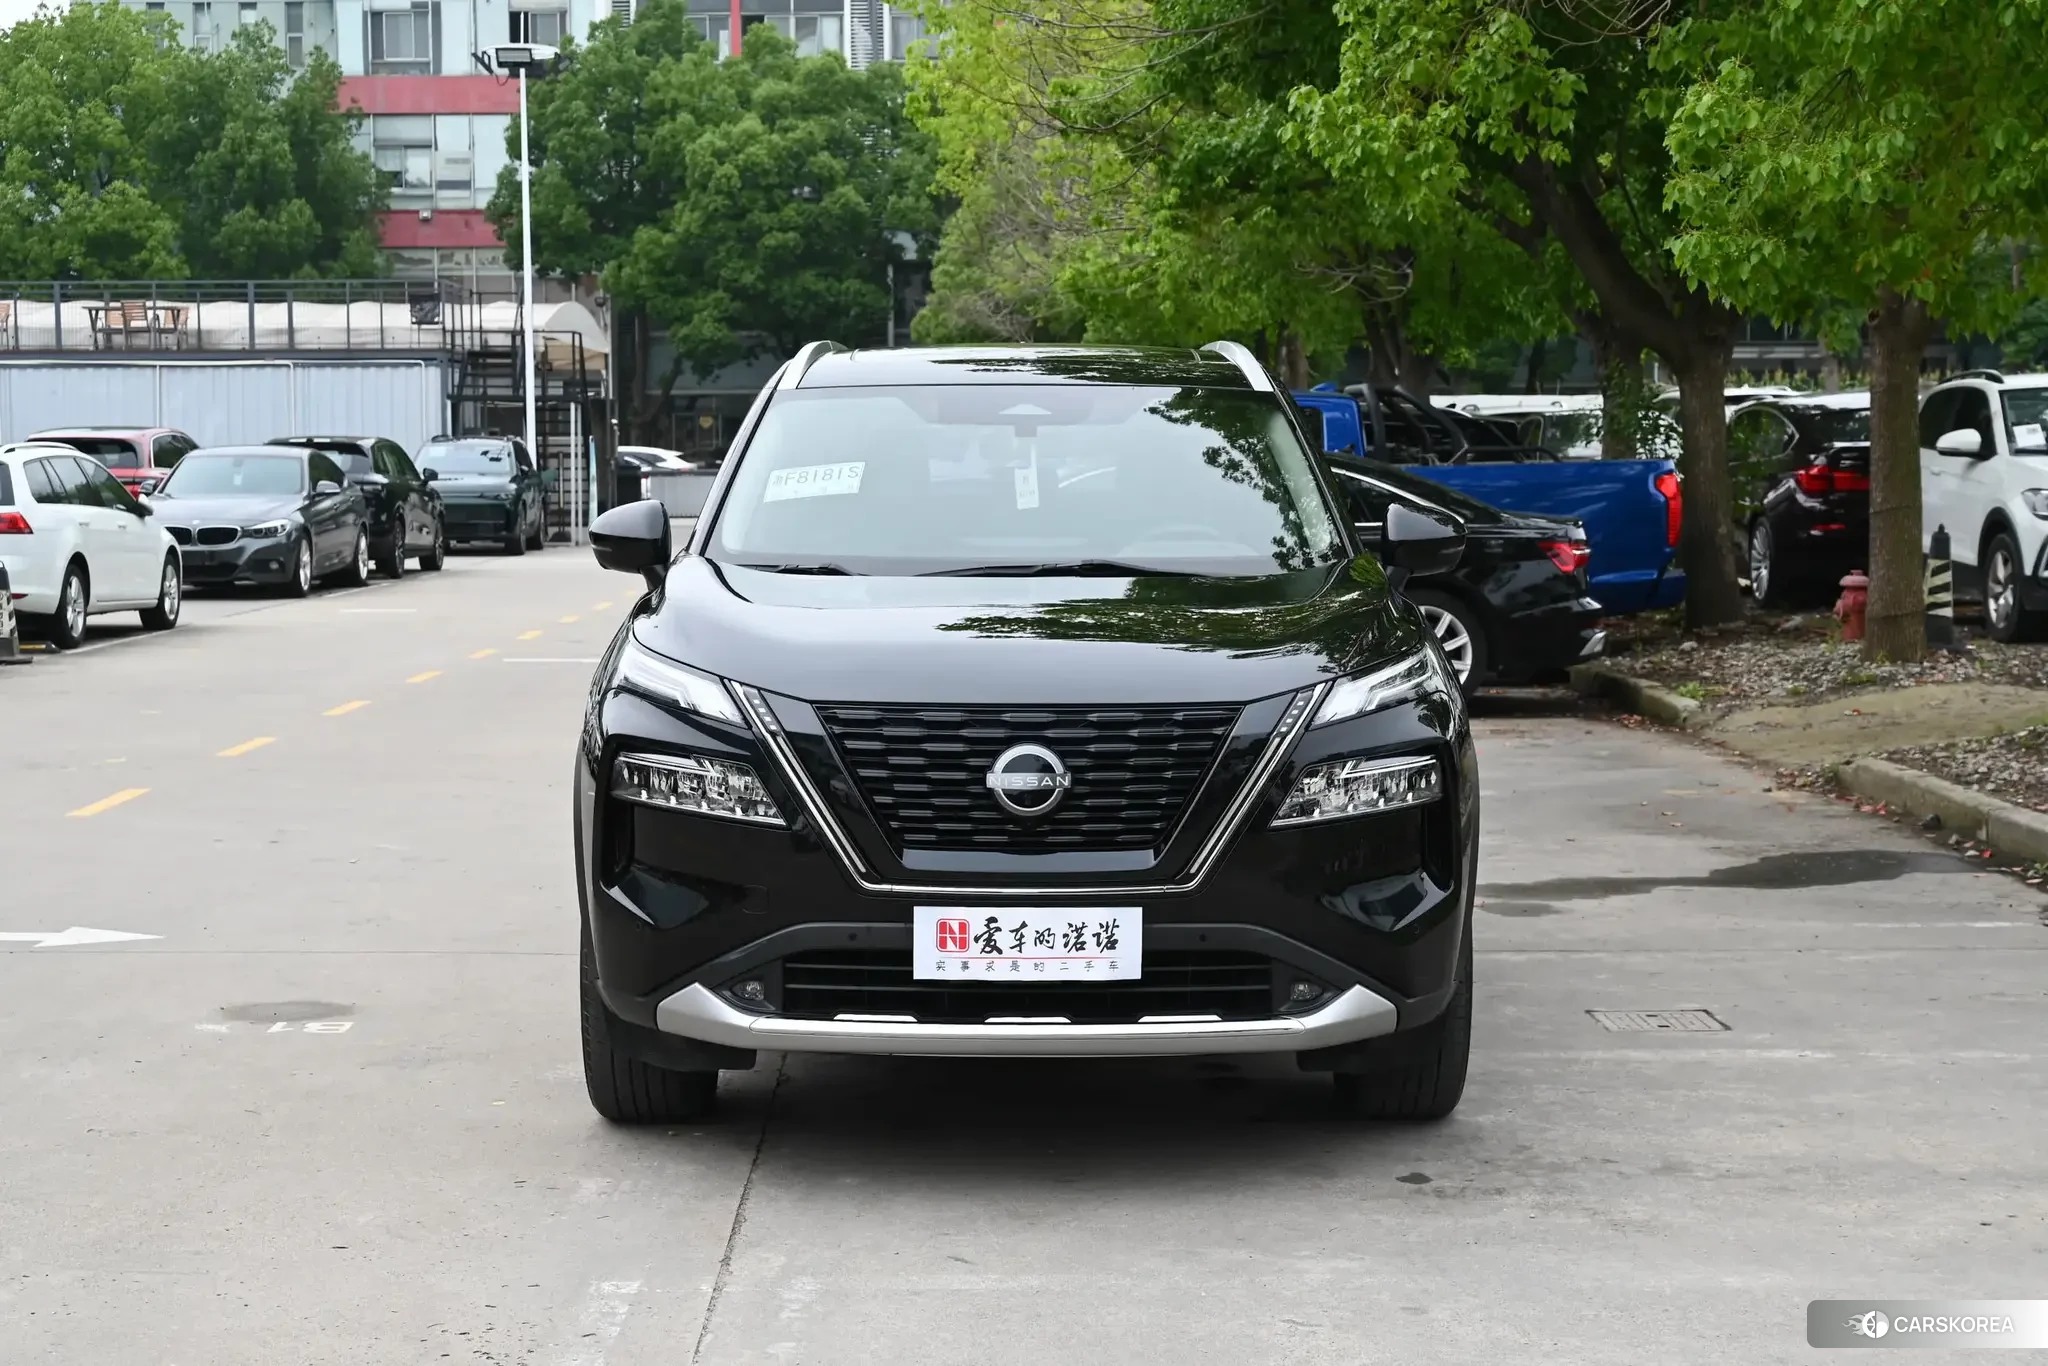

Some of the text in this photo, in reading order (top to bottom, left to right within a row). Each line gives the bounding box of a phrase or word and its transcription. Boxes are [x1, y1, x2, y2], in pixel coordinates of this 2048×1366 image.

[989, 776, 1069, 787] NISSAN
[935, 960, 1119, 972] 实事求是的二手车
